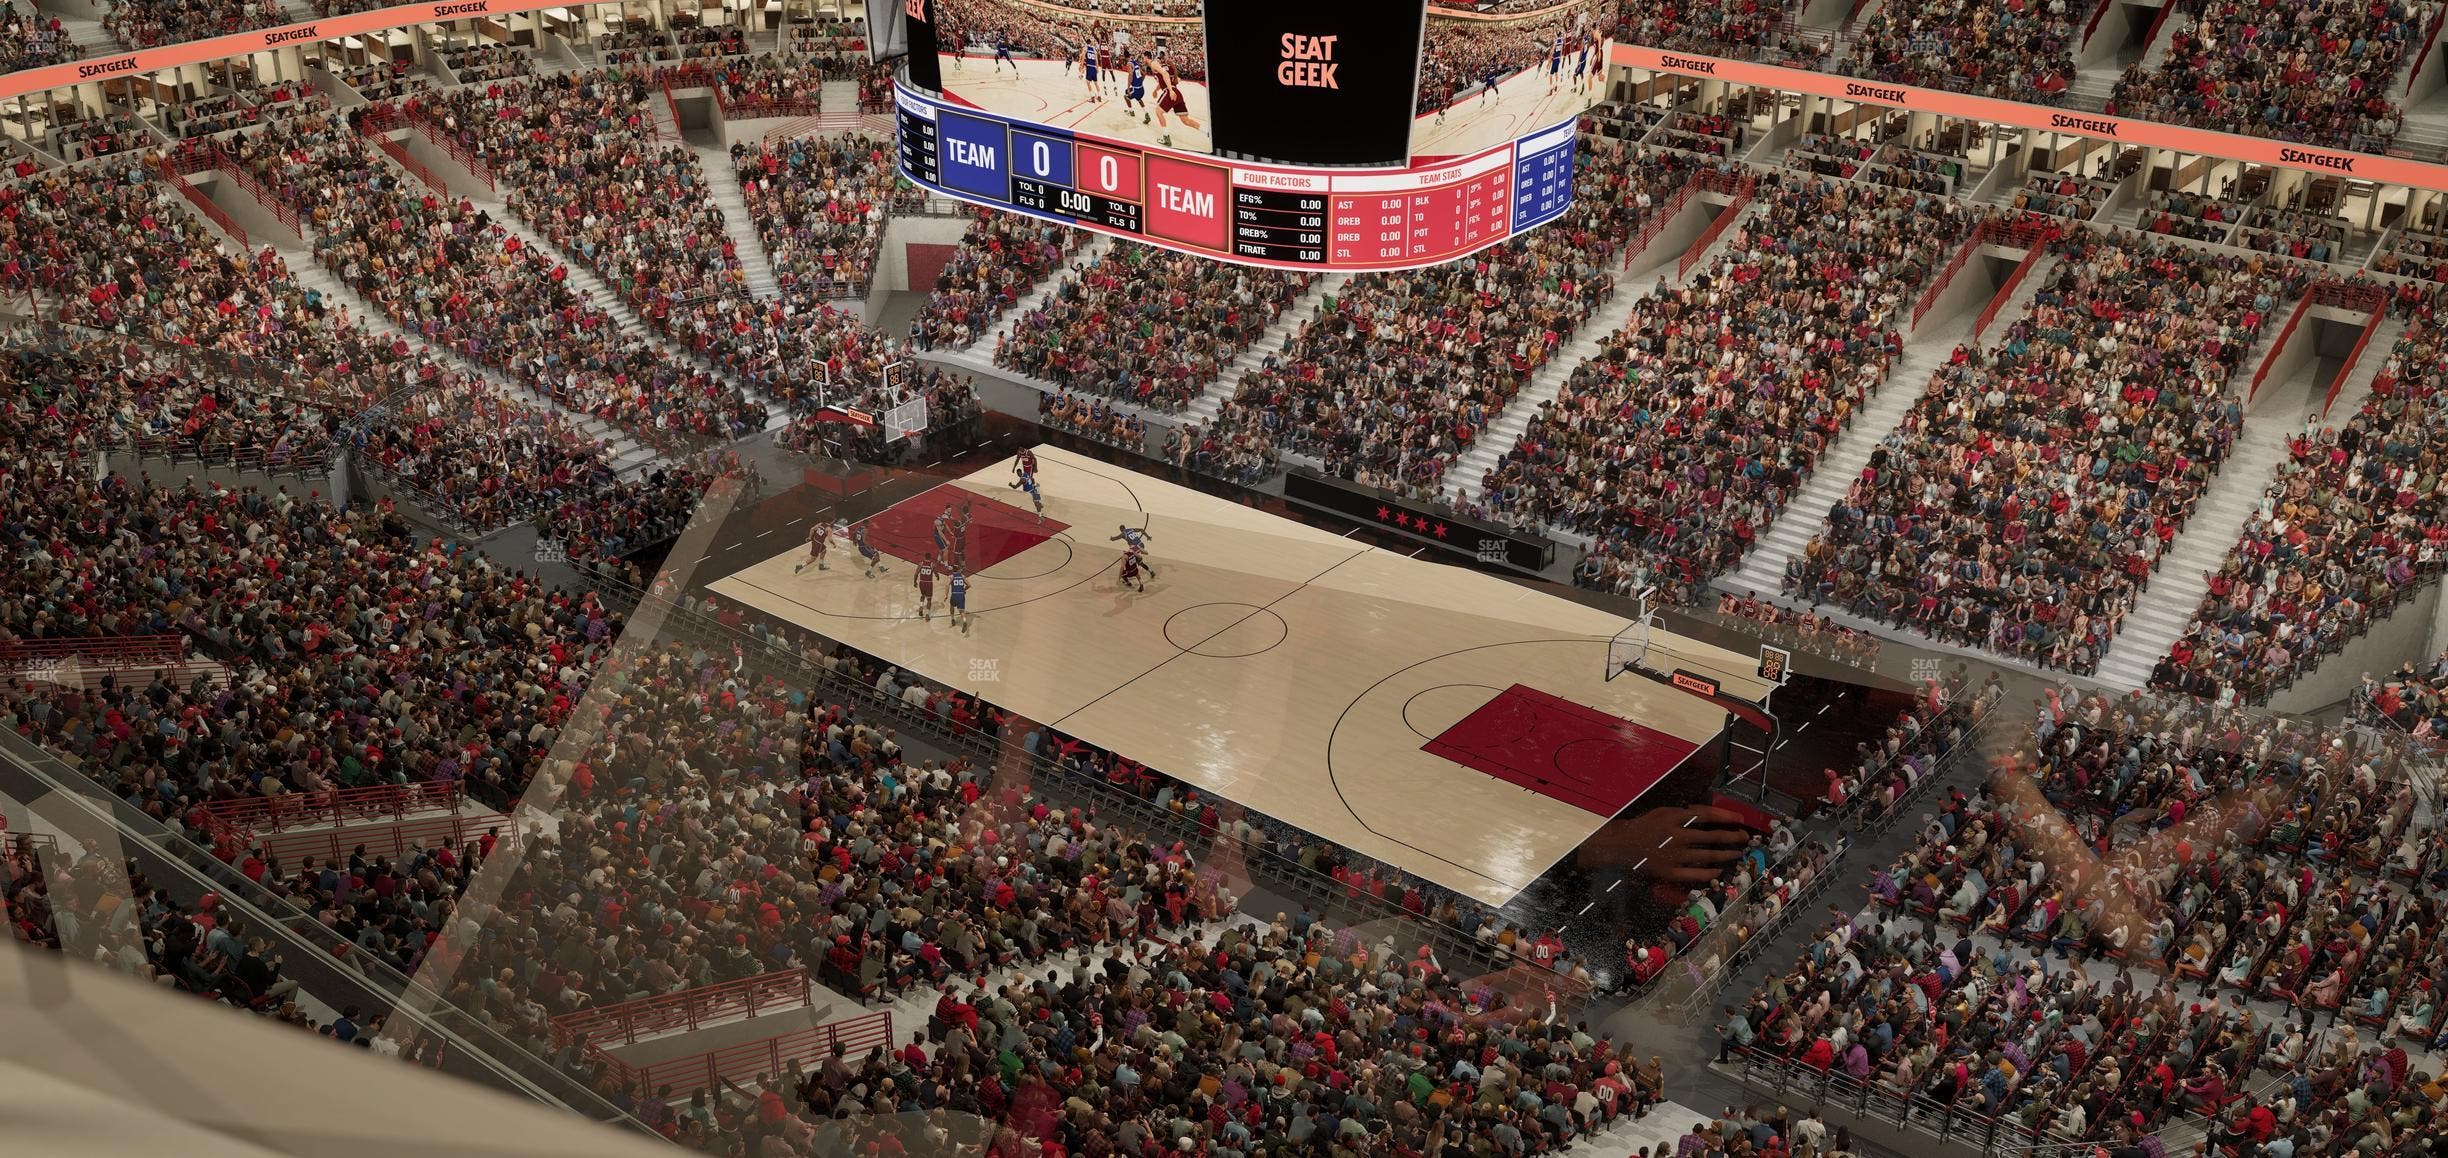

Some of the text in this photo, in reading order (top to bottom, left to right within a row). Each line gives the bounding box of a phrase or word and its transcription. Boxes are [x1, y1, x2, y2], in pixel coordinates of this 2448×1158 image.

[434, 1, 488, 16] SEATGEEK
[265, 26, 318, 45] SEATGEEK
[1281, 32, 1337, 61] SEAT
[78, 57, 137, 78] SEATGEEK
[1661, 56, 1715, 74] SEATGEEK
[1278, 61, 1339, 90] GEEK
[1846, 83, 1906, 103] SEATGEEK
[2051, 114, 2118, 136] SEATGEEK
[946, 137, 995, 171] TEAM
[1033, 141, 1050, 177] 0
[2280, 149, 2354, 172] SEATGEEK
[1100, 155, 1118, 192] 0
[1243, 173, 1311, 188] FOUR FACTORS
[1420, 168, 1461, 184] TEAM STATS
[1019, 181, 1044, 195] TOL 0
[1020, 196, 1044, 209] FLS 0
[1061, 190, 1091, 212] 0:00
[1108, 202, 1135, 215] TOL 0
[1157, 183, 1214, 219] TEAM
[1300, 200, 1321, 209] 0.00
[1338, 199, 1401, 209] AST 0.00
[1416, 196, 1429, 205] BLK
[1109, 216, 1135, 230] FLS 0
[1239, 210, 1321, 227] TO% 0.00
[1338, 215, 1401, 225] OREB 0.00
[1415, 213, 1424, 221] TO
[1239, 228, 1321, 243] OREB% 0.00
[1381, 231, 1400, 241] 0.00
[1414, 228, 1428, 237] POT
[1239, 244, 1320, 260] FTRATE 0.00
[1337, 247, 1400, 257] STL 0.00
[1413, 244, 1425, 253] STL
[1678, 677, 1710, 693] SEATGEEK
[1536, 945, 1548, 958] 00
[1599, 1085, 1614, 1102] 00
